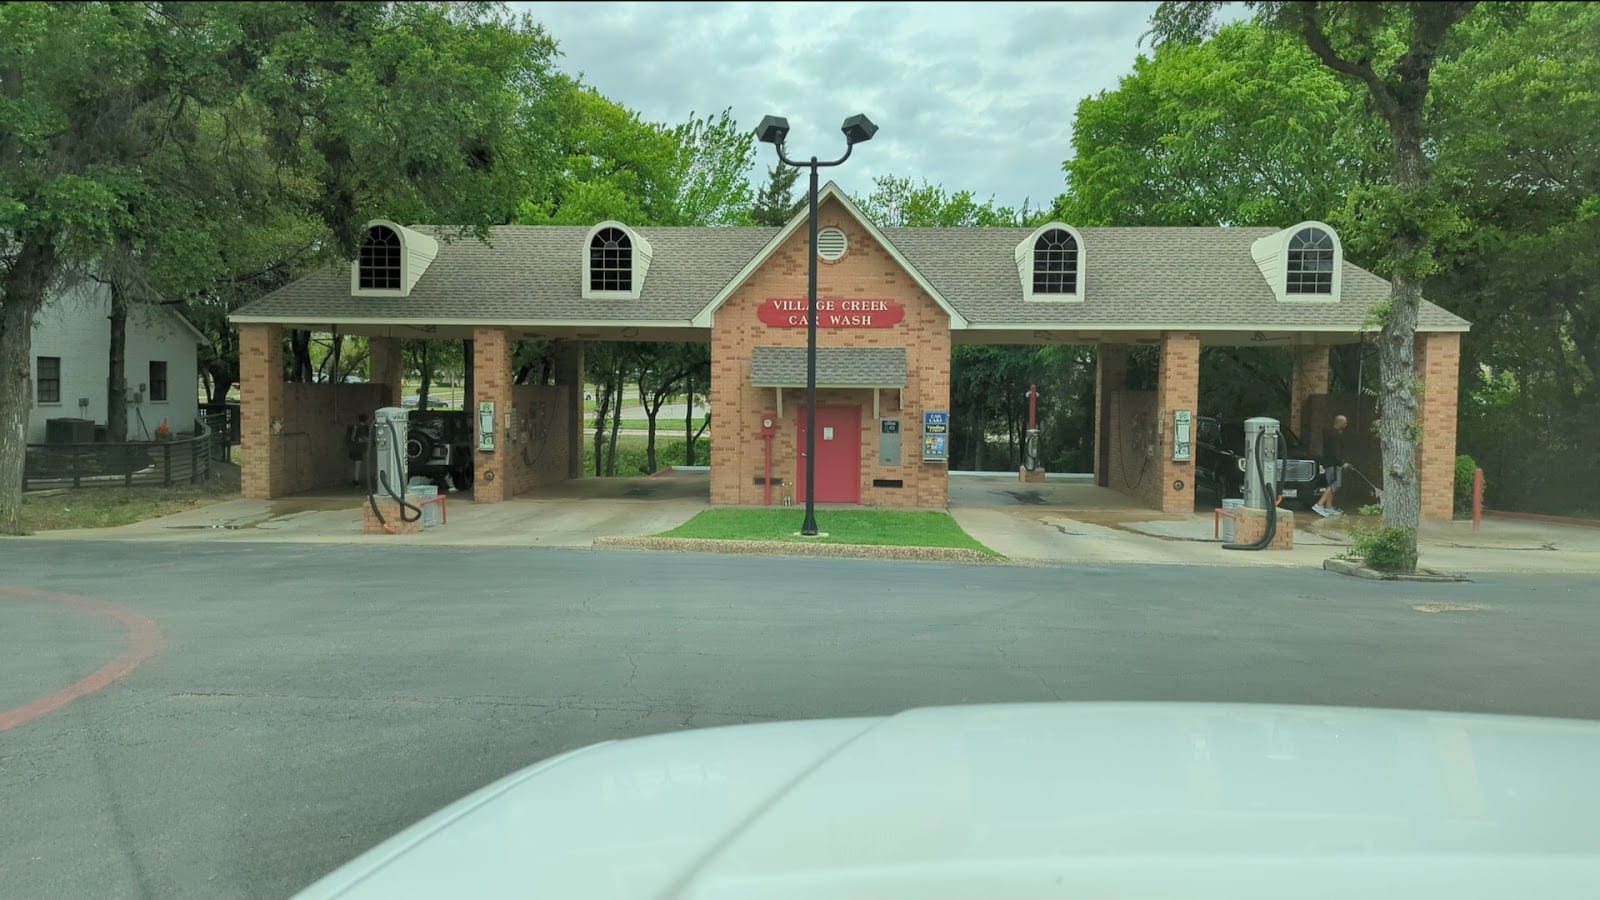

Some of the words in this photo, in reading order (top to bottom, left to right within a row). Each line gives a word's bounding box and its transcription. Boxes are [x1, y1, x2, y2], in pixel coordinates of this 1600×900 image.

[773, 300, 835, 311] VILLGE
[842, 300, 888, 311] CREEK
[788, 315, 819, 325] CA
[830, 315, 872, 325] WASH
